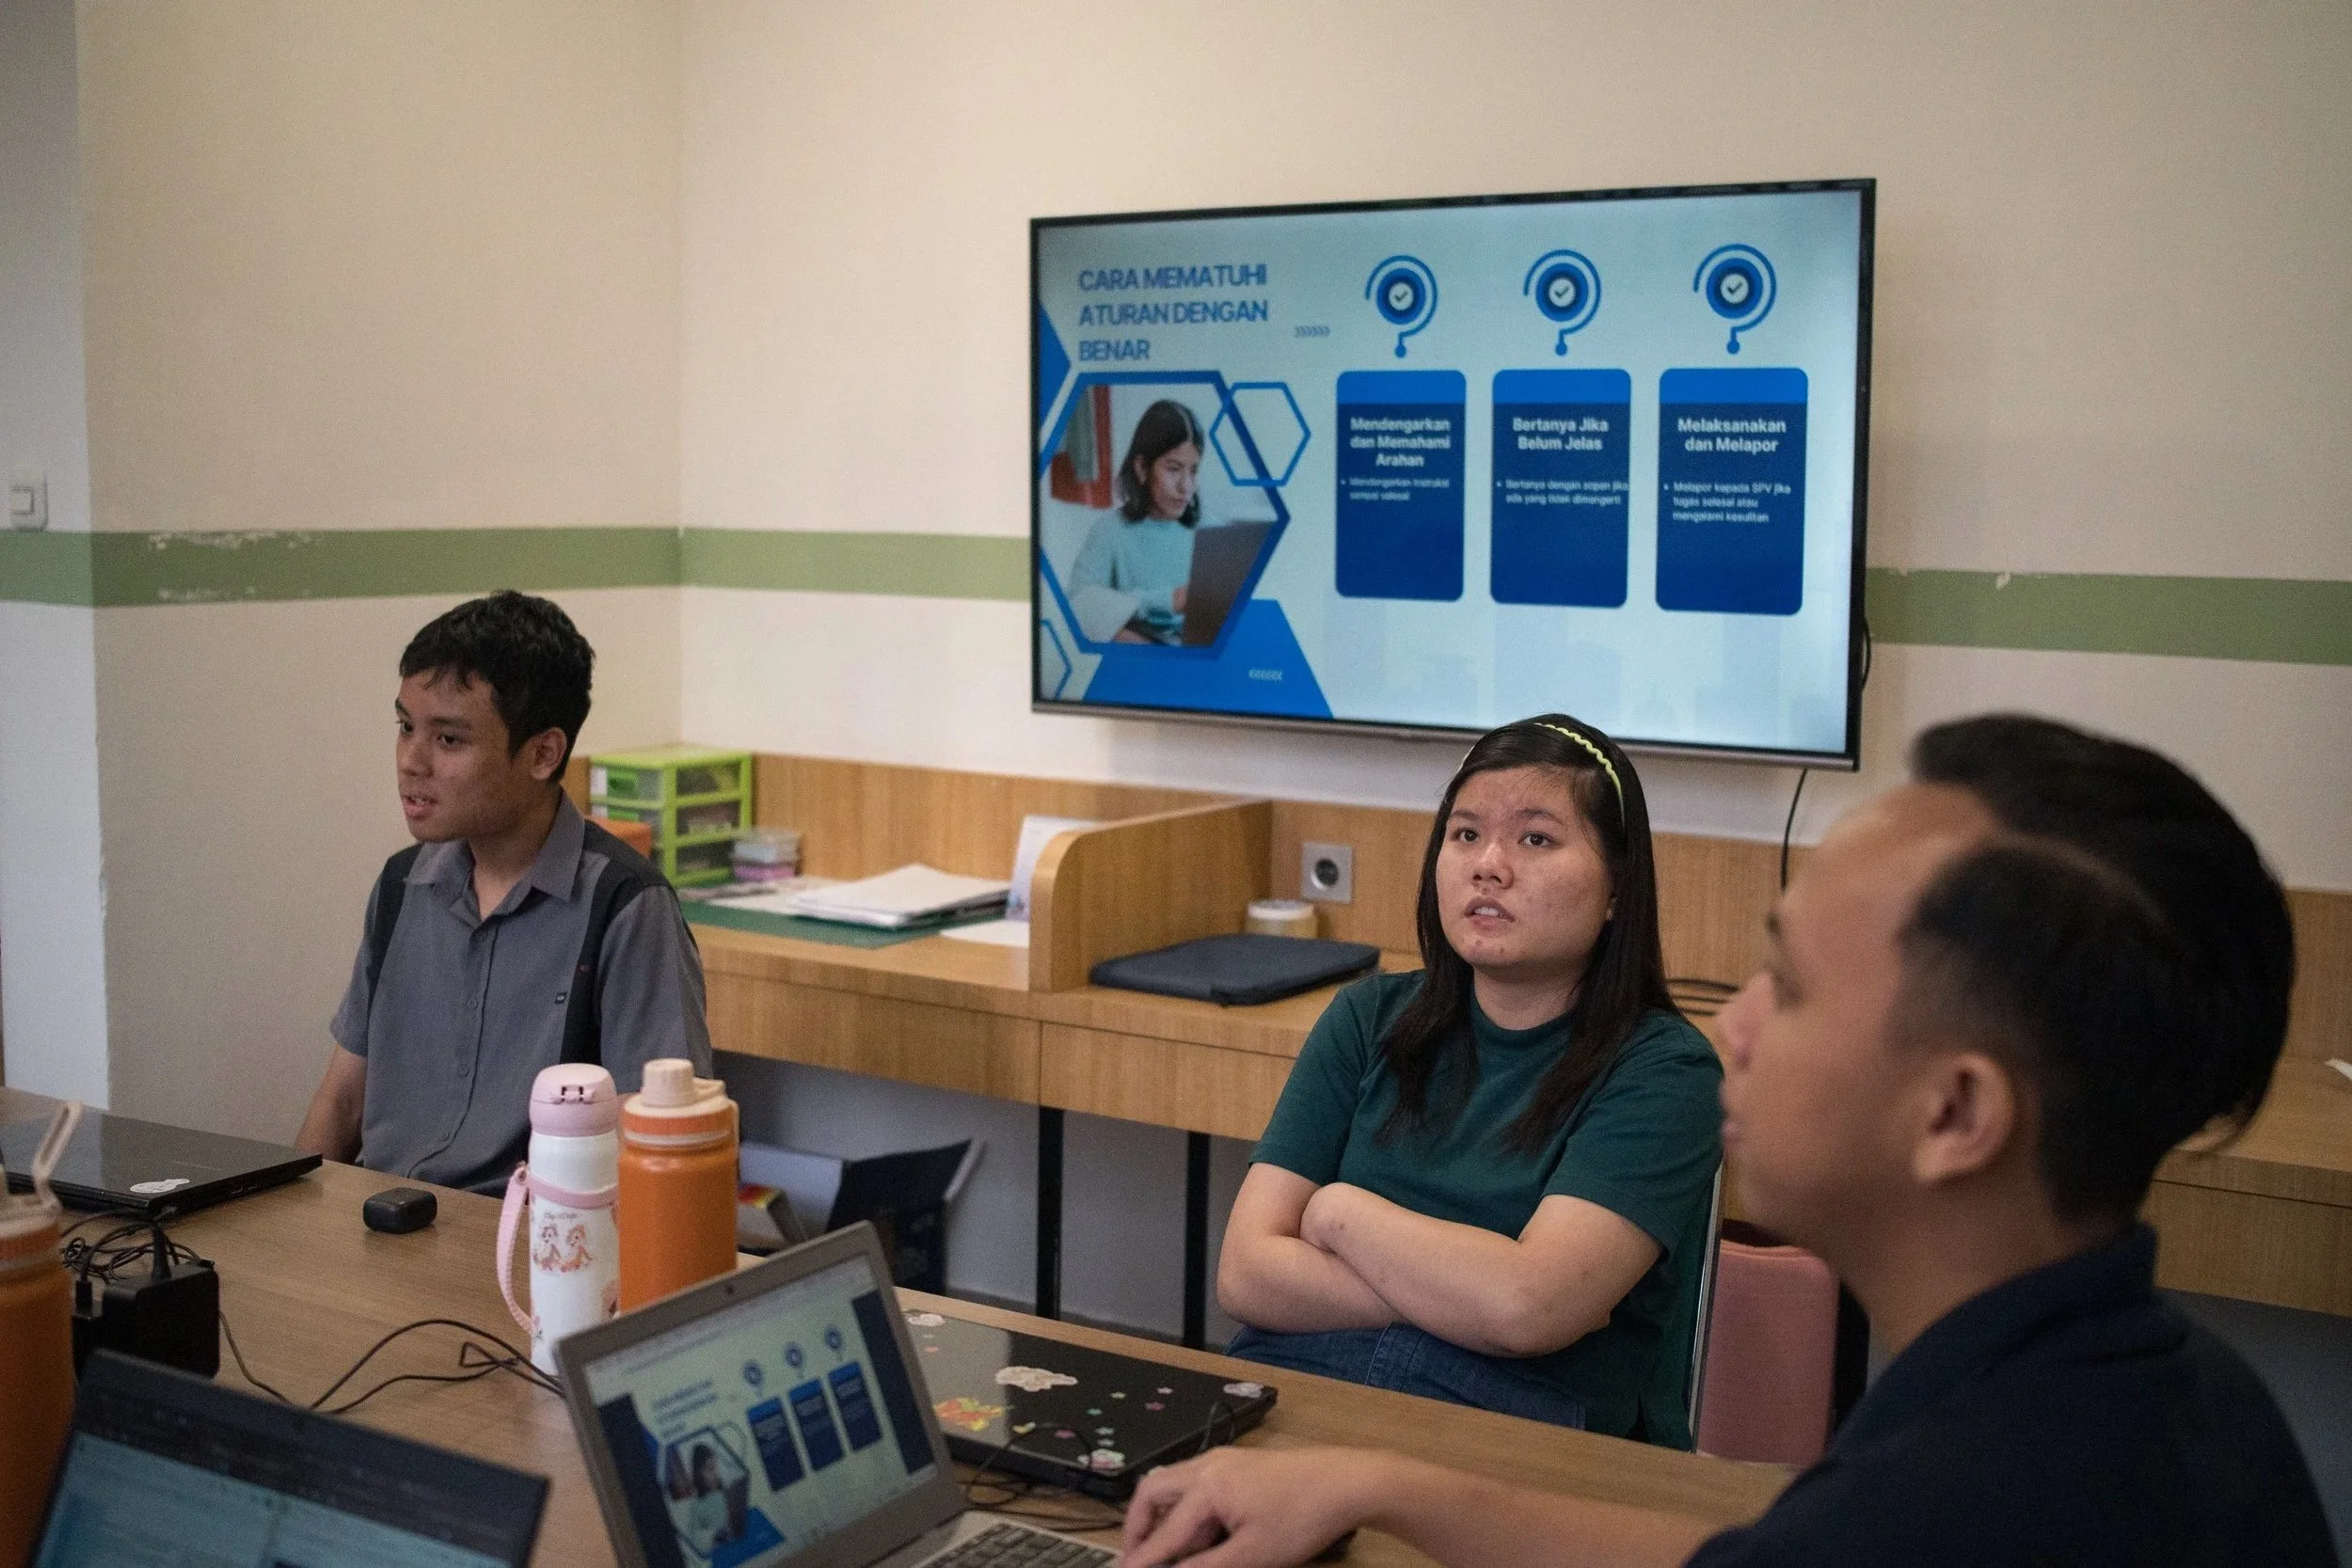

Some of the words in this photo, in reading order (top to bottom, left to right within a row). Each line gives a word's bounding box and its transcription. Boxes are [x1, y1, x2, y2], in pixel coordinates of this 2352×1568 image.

[1078, 268, 1138, 291] CARA
[1142, 263, 1267, 290] MEMATUHI
[1079, 303, 1168, 326] ATURAN
[1172, 300, 1267, 325] DENGAN
[1078, 339, 1150, 361] BENAR
[1350, 417, 1450, 435] Mendengarkan
[1512, 417, 1577, 436] Bertanya
[1579, 417, 1609, 432] Jika
[1677, 417, 1787, 433] Melaksanakan
[1350, 435, 1375, 449] dan
[1518, 435, 1563, 451] Belum
[1565, 436, 1602, 451] Jelas
[1684, 437, 1713, 451] dan
[1715, 436, 1779, 455] Melapor
[1375, 452, 1424, 467] Arahan
